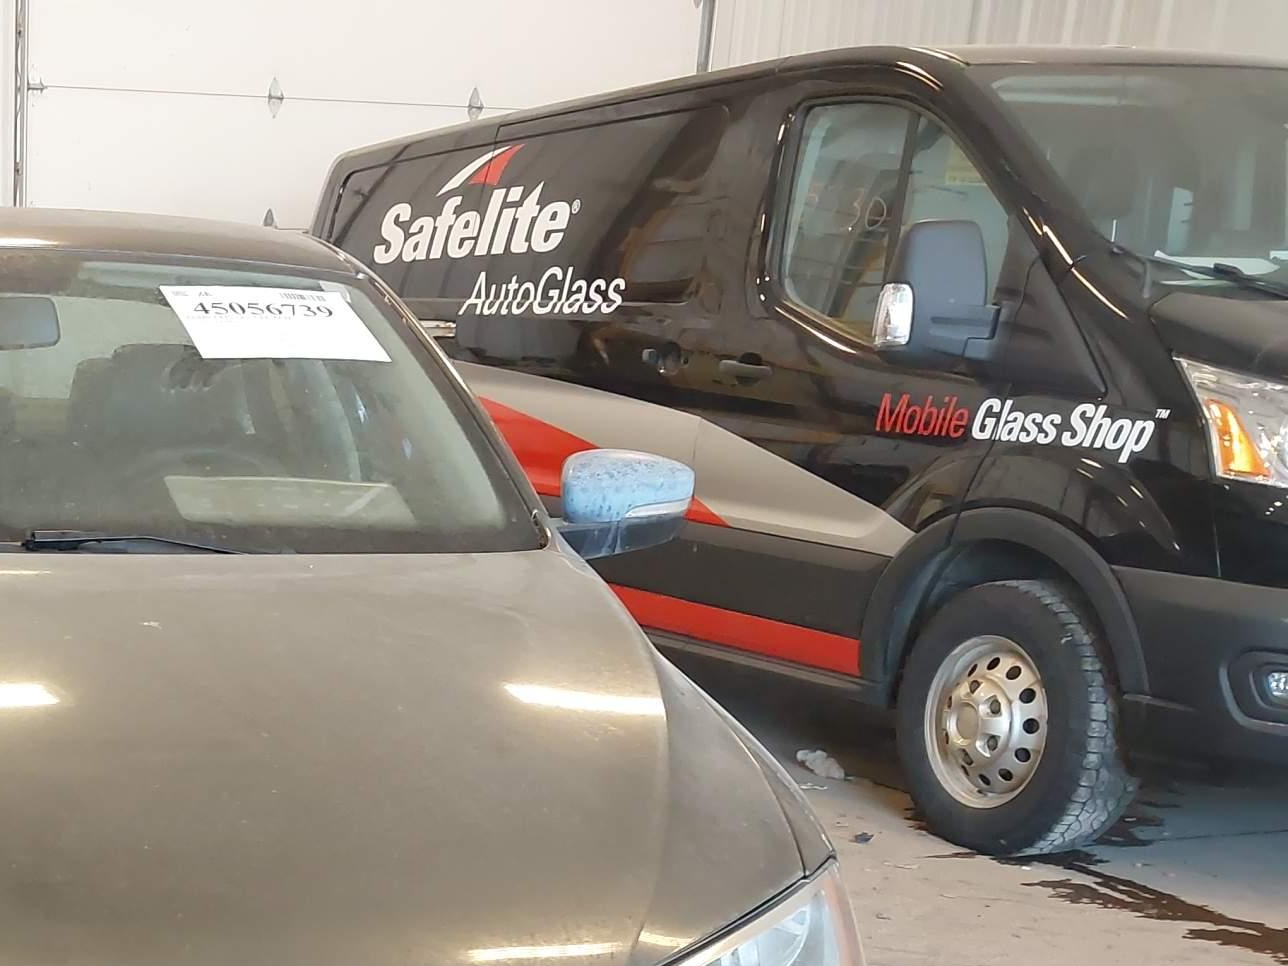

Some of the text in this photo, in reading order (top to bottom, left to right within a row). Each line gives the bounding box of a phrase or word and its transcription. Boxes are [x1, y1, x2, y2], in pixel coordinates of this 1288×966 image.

[193, 302, 333, 318] 45056739
[458, 266, 626, 316] AutoGlass
[875, 392, 968, 438] Mobile
[972, 398, 1061, 444] Glass
